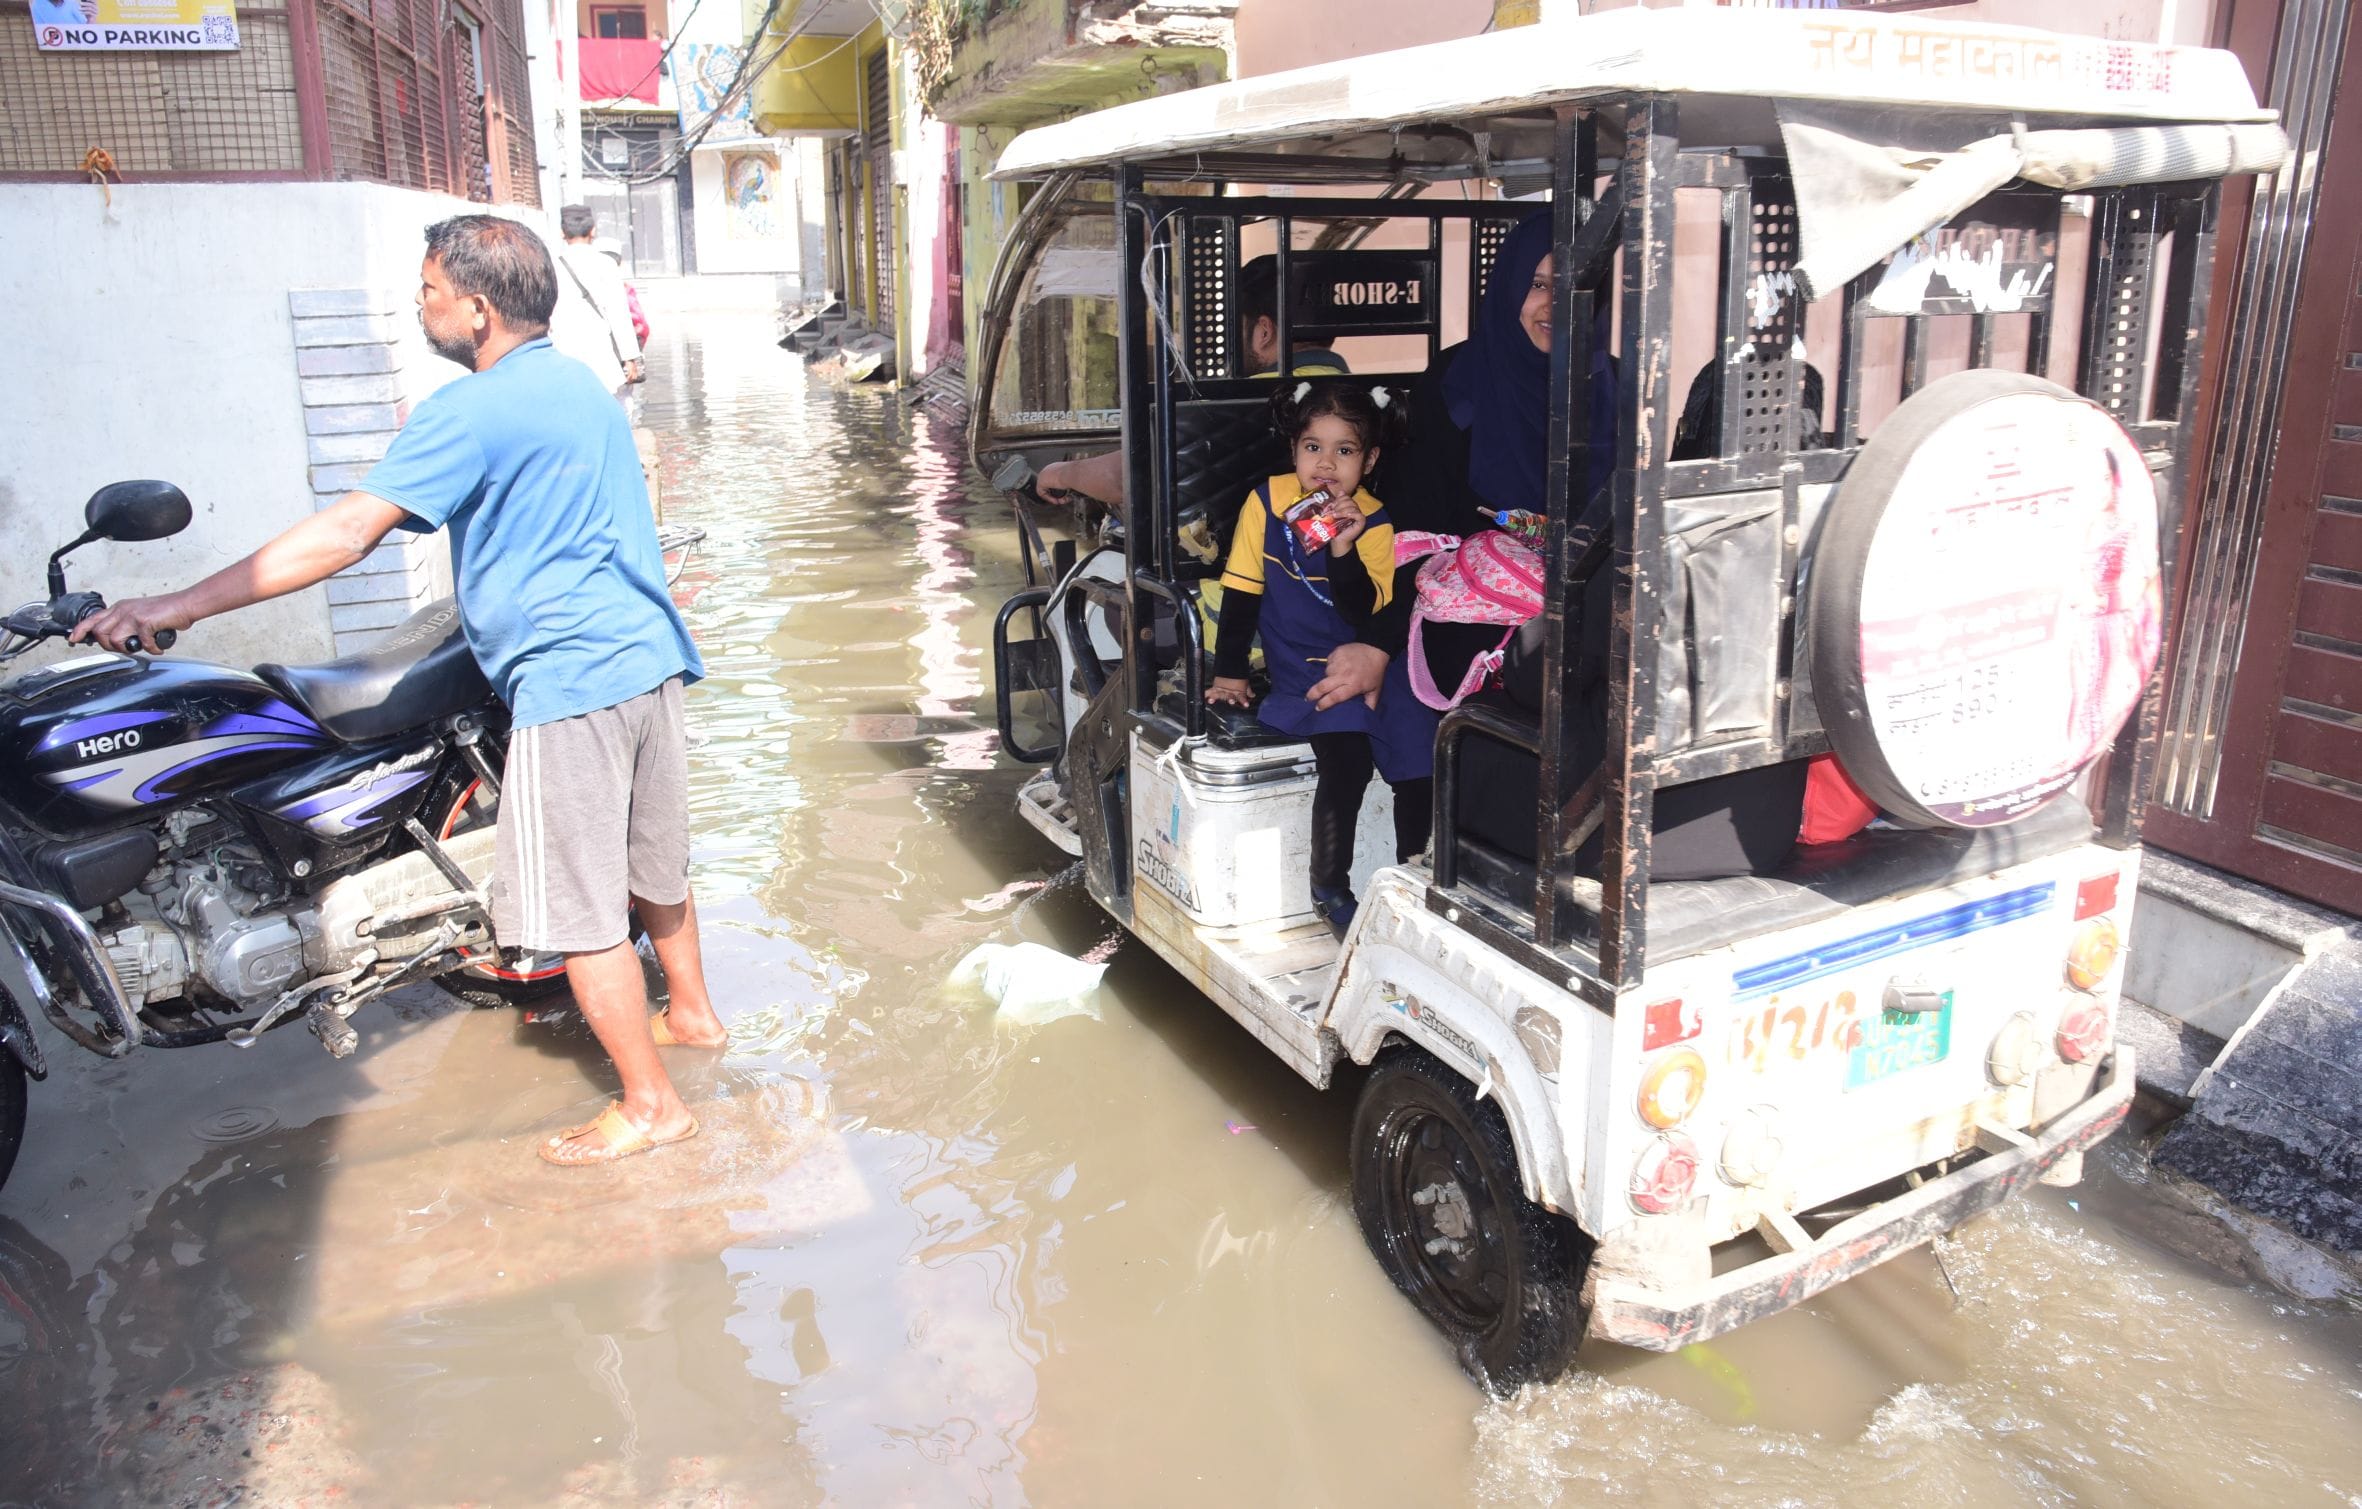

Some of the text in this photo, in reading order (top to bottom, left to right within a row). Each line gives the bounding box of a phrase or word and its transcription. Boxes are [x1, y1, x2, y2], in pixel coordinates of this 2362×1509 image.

[65, 29, 202, 45] NO PARKING
[1801, 22, 1878, 73] जय
[77, 729, 141, 758] Hero
[1137, 838, 1202, 913] SHOBHA
[1420, 1005, 1483, 1063] SHOBHA
